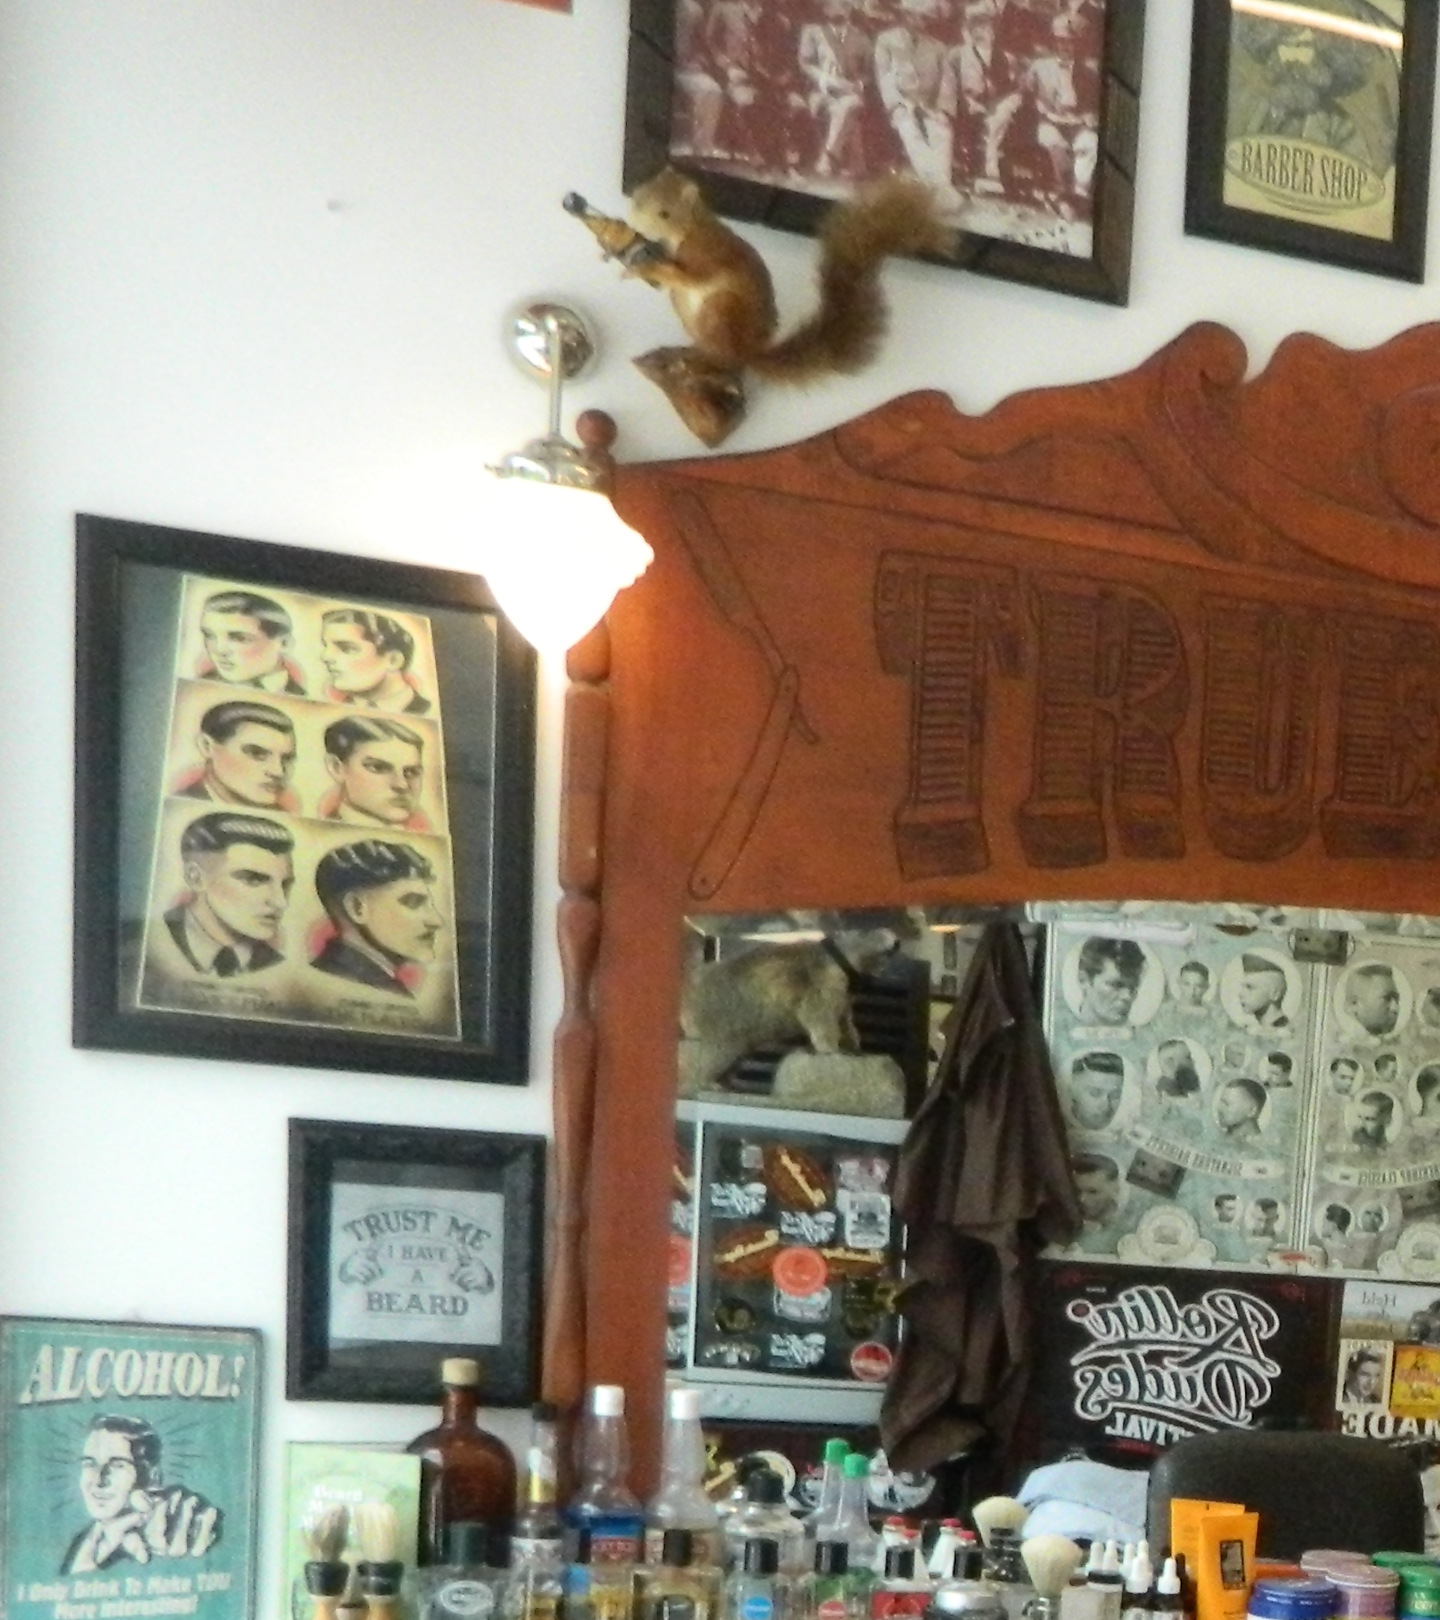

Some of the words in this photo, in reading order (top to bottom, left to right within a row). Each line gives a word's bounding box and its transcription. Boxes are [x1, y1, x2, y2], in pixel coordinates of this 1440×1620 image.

[1241, 142, 1315, 196] BARBER
[1319, 154, 1368, 201] SHOP
[343, 1209, 438, 1242] TRUST
[447, 1215, 492, 1251] ME
[401, 1246, 448, 1263] HAVE
[411, 1269, 424, 1284] A
[366, 1290, 470, 1317] BEARD
[20, 1344, 246, 1404] ALCOHOL!
